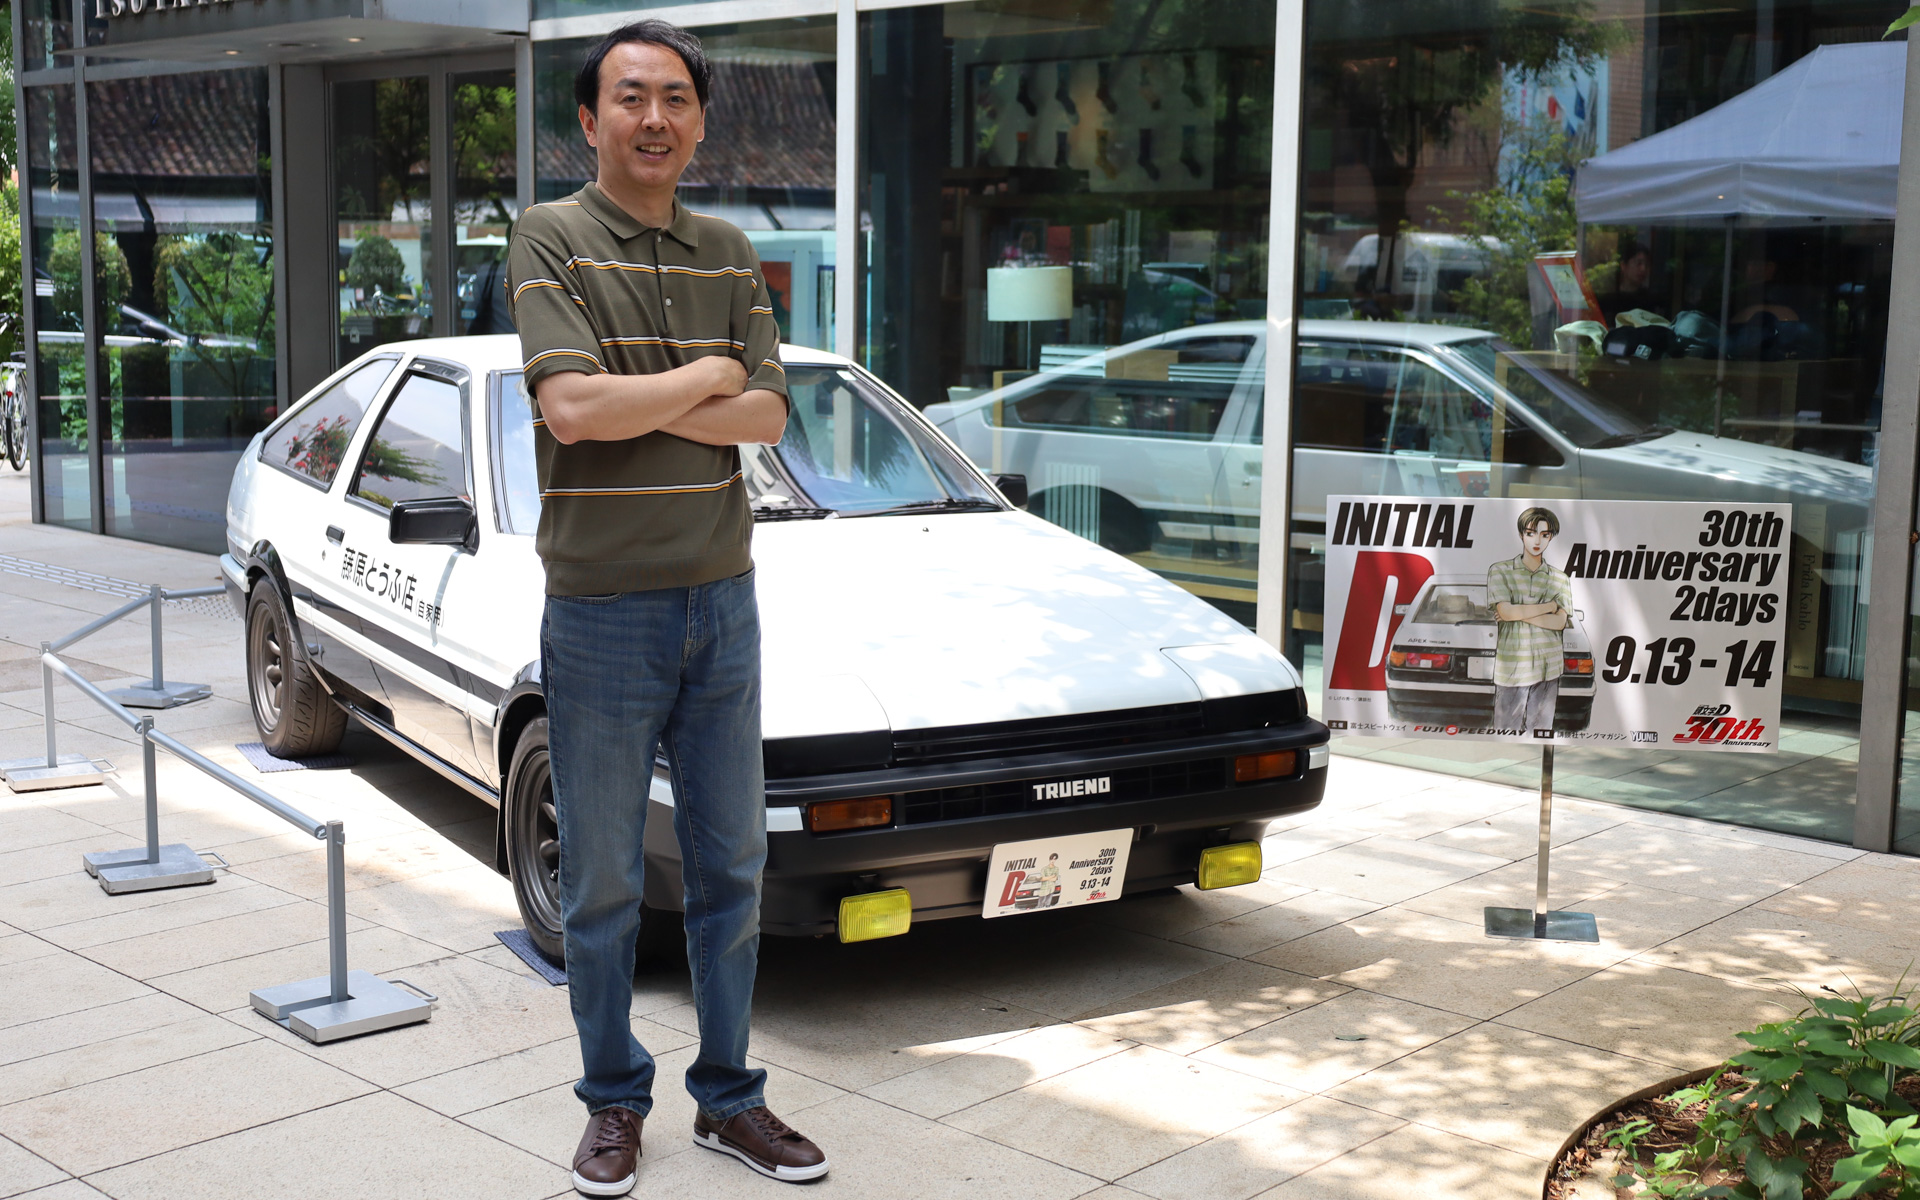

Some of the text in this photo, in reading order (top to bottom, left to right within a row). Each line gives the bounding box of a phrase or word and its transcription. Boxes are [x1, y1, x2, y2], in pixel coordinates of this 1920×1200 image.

[1331, 502, 1475, 548] INITIAL
[1699, 509, 1785, 548] 30th
[1564, 543, 1782, 587] Anniversary
[341, 547, 417, 613] 藤原とうふ店
[1799, 553, 1815, 631] Frida Kahlo
[1668, 584, 1779, 627] 2days
[1328, 550, 1435, 691] D
[1350, 722, 1407, 731] 富士スピードウェイ
[1672, 716, 1765, 745] 30th
[1721, 739, 1771, 748] Anniversary
[1032, 776, 1111, 801] TRUENO
[1003, 857, 1038, 872] INITIAL
[1069, 856, 1115, 870] Anniversary
[1098, 848, 1117, 858] 30th
[1090, 866, 1113, 876] 2days
